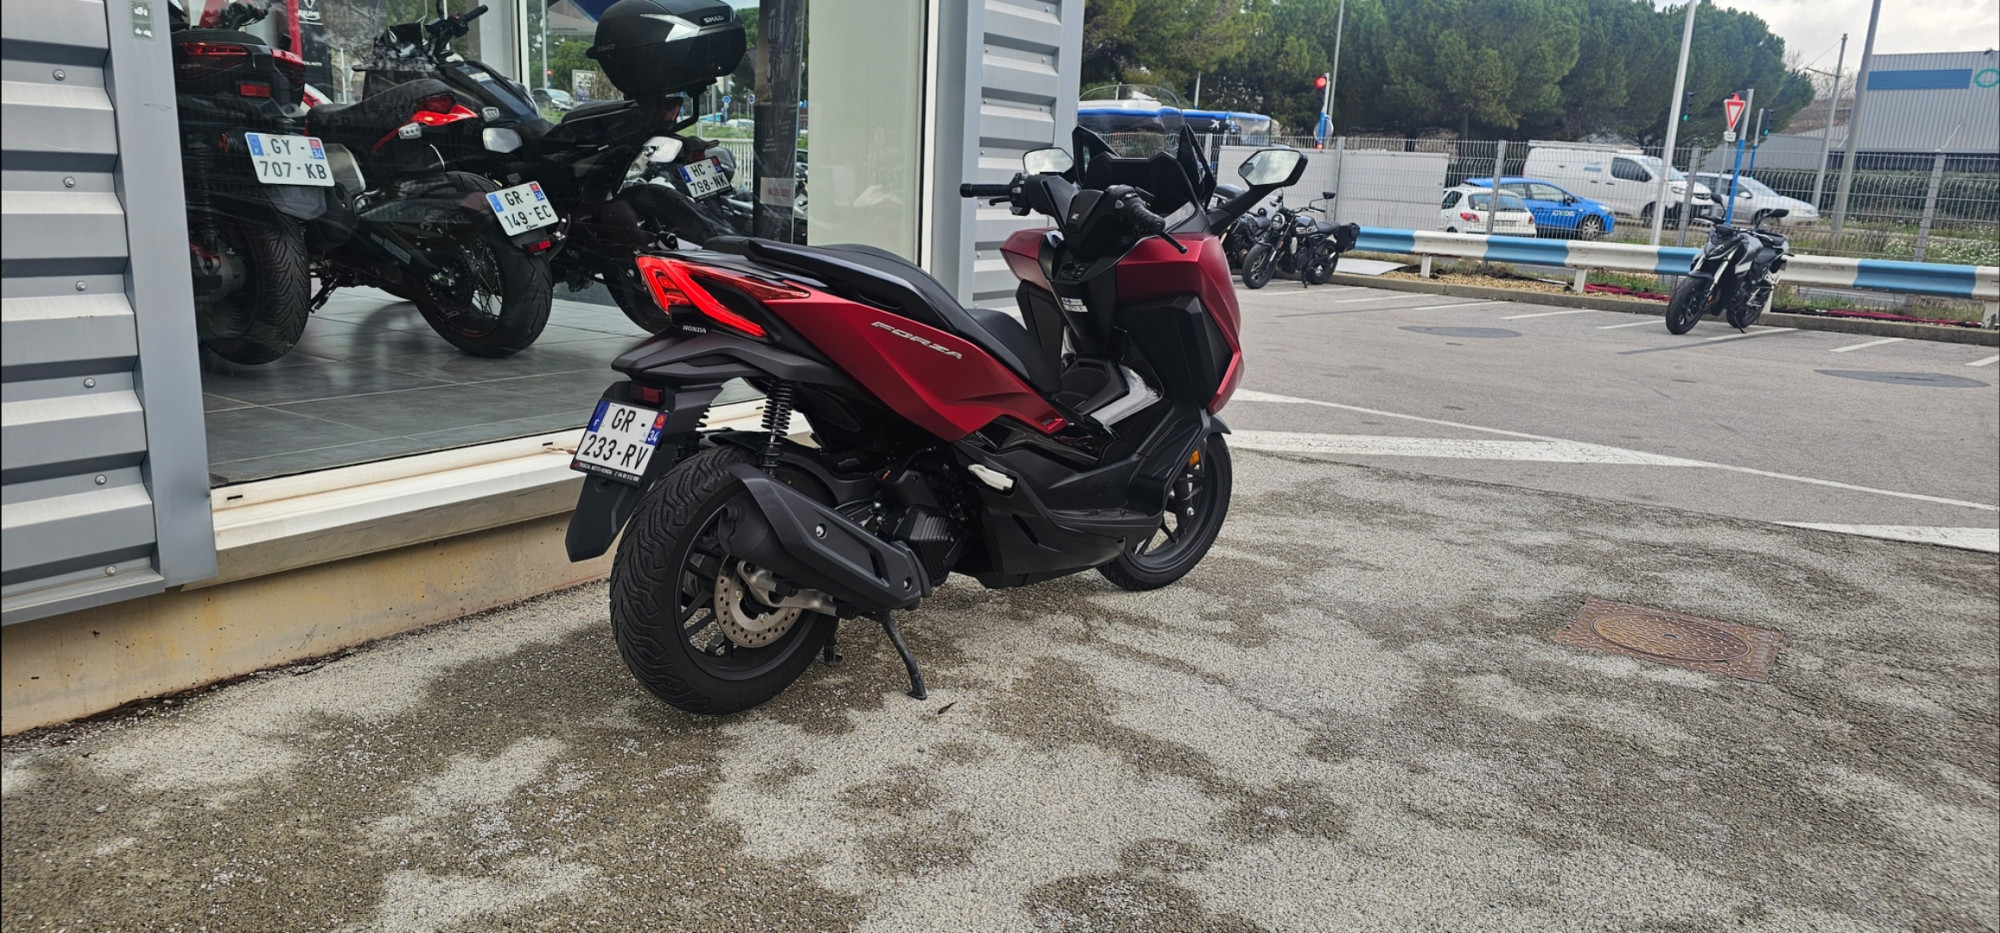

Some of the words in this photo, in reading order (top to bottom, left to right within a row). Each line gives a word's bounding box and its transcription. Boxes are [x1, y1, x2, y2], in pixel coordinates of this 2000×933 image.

[703, 15, 725, 24] SHAD
[270, 138, 292, 155] GY
[259, 160, 327, 180] 707-KB
[690, 163, 706, 177] HC
[690, 173, 728, 195] 798-NK
[504, 190, 524, 206] GR
[504, 204, 552, 229] 149-EC
[682, 324, 707, 334] HONDA
[870, 321, 962, 360] FORZA
[593, 419, 600, 427] F
[611, 408, 637, 433] GR
[647, 430, 661, 443] 34
[582, 434, 649, 470] 233-RV
